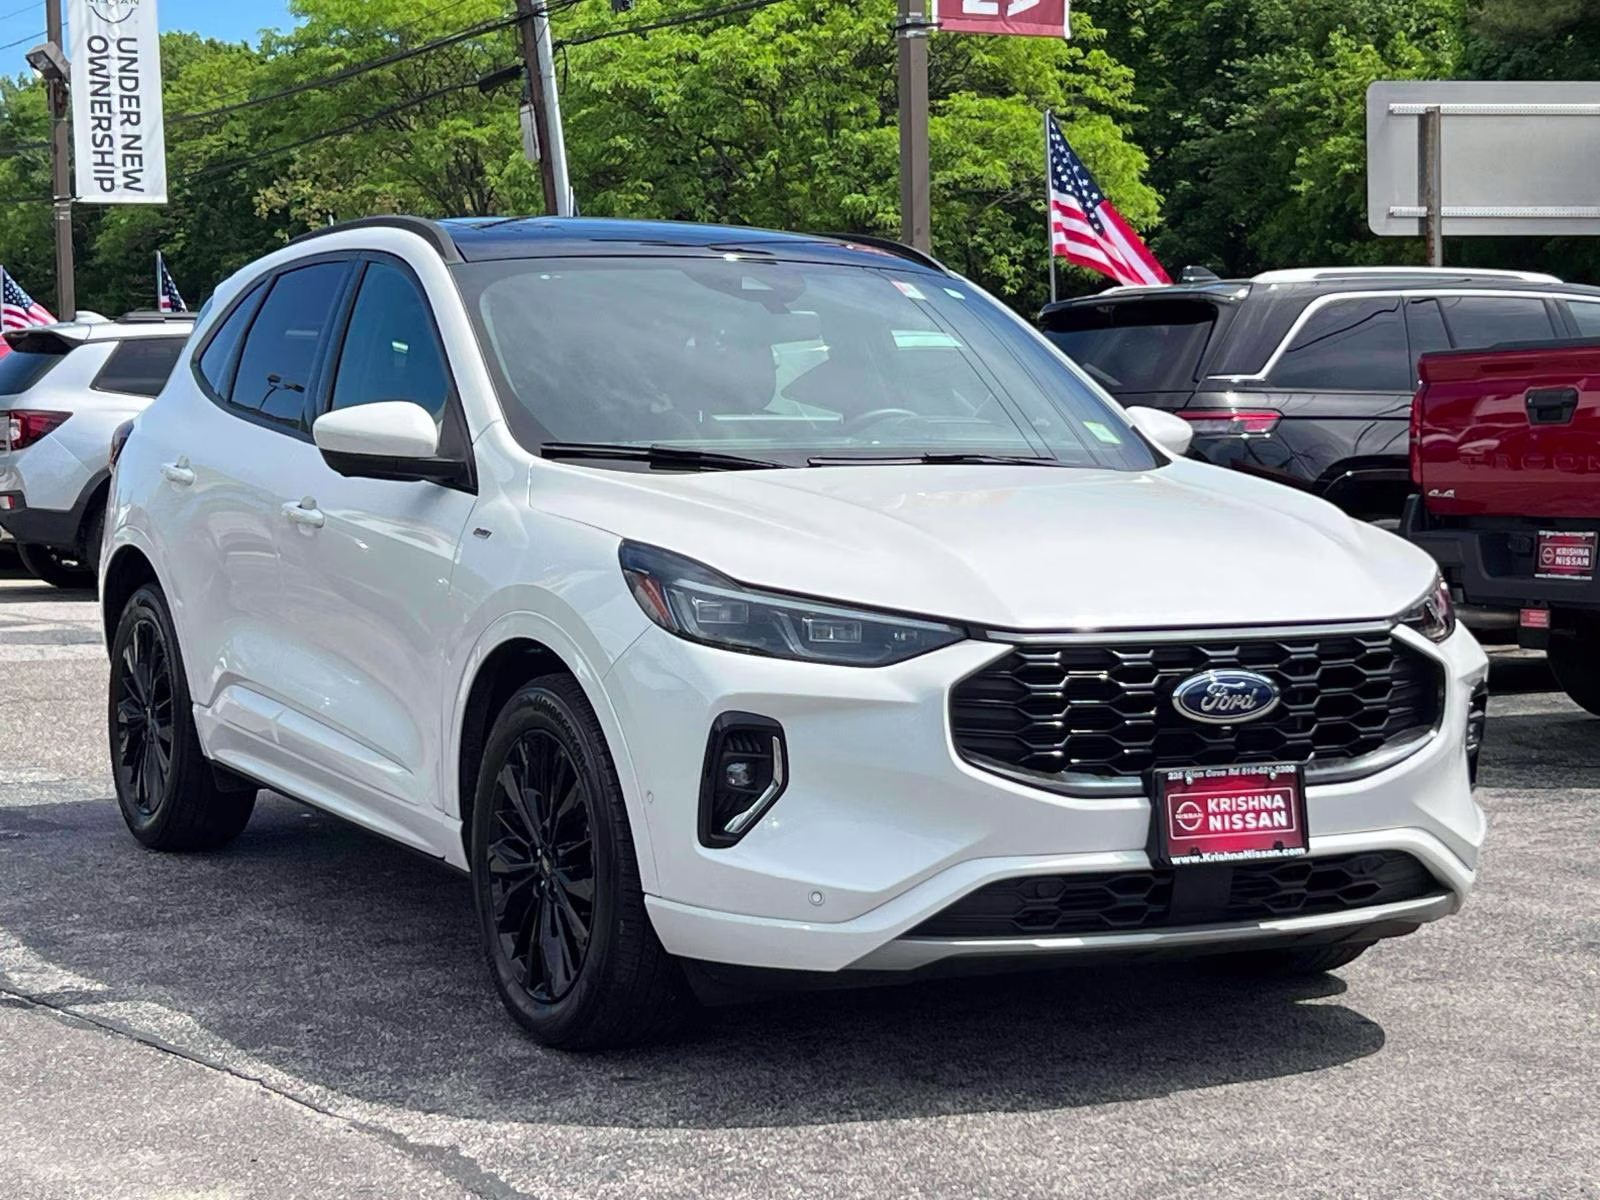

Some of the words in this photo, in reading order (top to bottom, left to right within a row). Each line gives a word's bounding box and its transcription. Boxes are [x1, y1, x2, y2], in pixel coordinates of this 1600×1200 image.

[116, 37, 141, 127] UNDER
[87, 35, 115, 193] OWNERSHIP
[121, 133, 145, 193] NEW
[1555, 547, 1590, 557] KRISHNA
[1555, 556, 1590, 566] NISSAN
[1200, 682, 1258, 711] Ford
[1207, 794, 1285, 813] KRISHNA
[1208, 811, 1287, 832] NISSAN
[1170, 847, 1305, 865] www.KrishnaNissan.com
